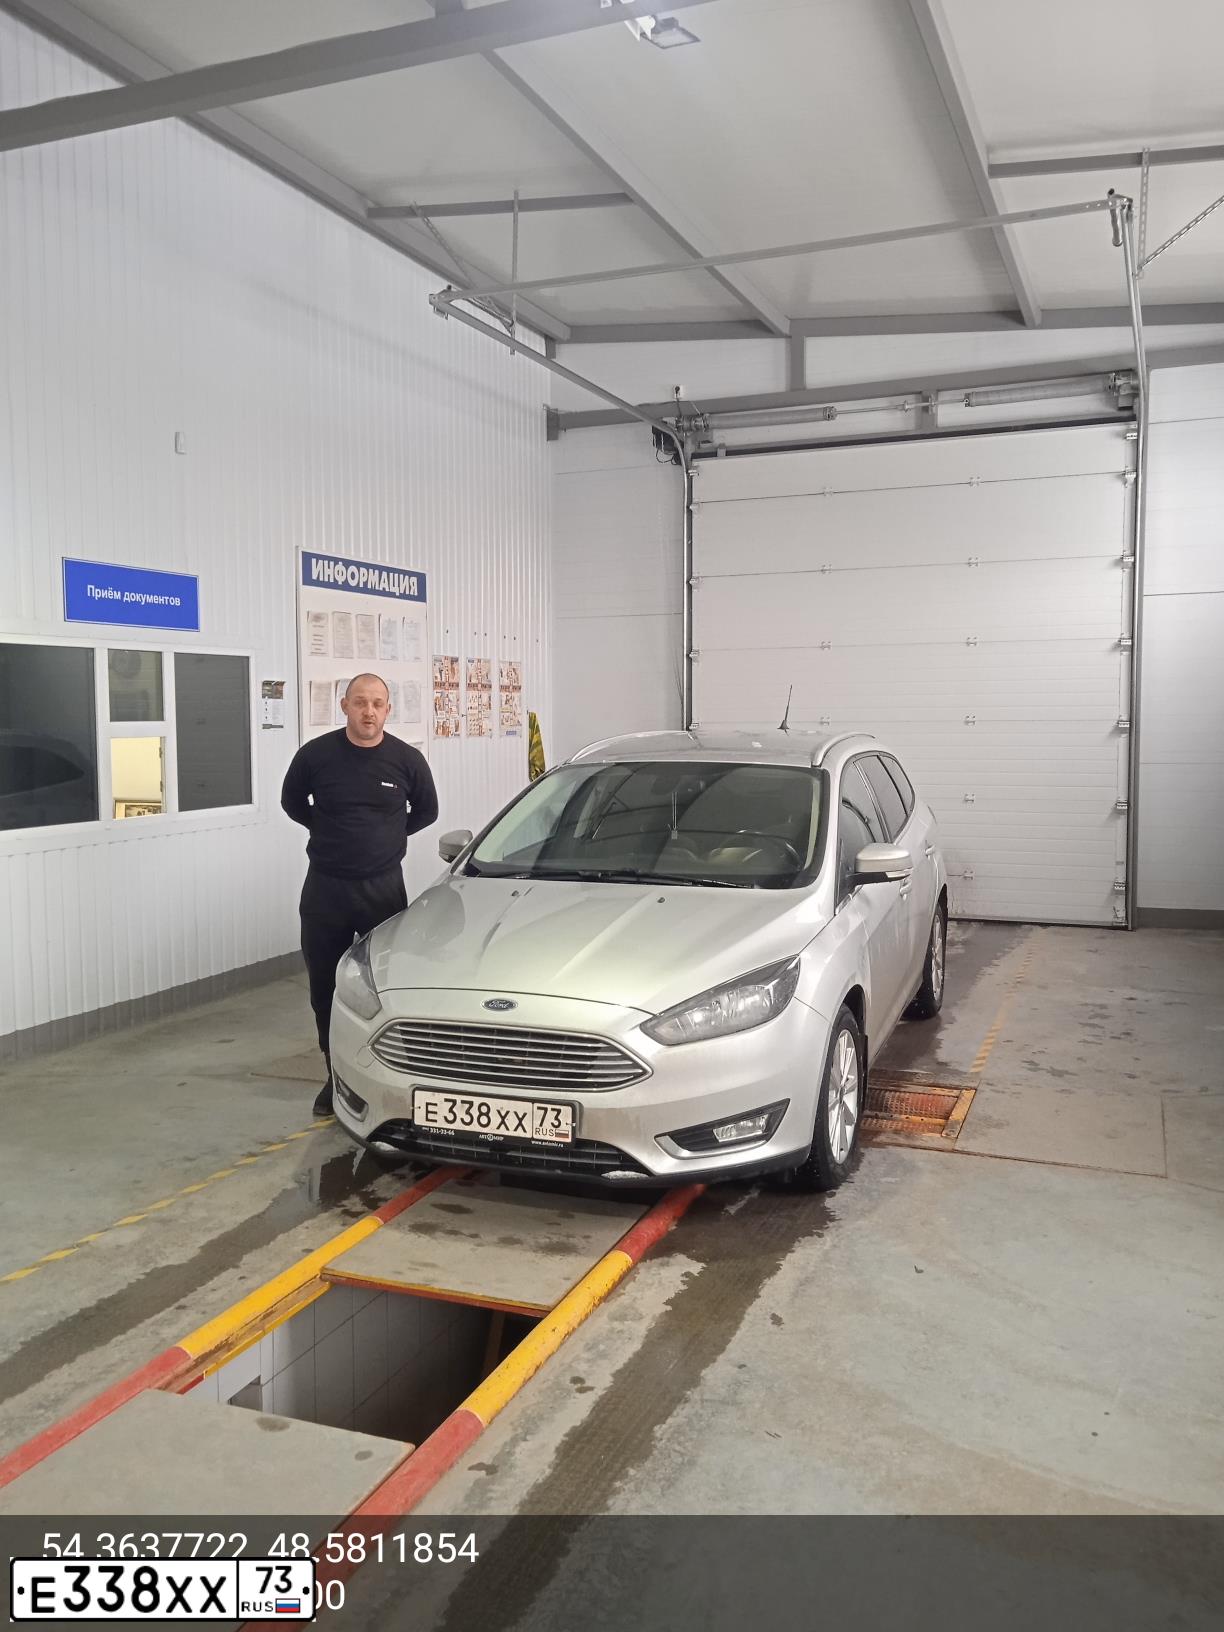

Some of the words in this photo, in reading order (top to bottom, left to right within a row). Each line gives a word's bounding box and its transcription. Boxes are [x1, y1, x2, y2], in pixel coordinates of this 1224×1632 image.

[311, 557, 419, 597] ИНФОРМАЦИЯ
[87, 584, 121, 600] Приём
[123, 591, 181, 606] документов
[536, 1105, 562, 1129] 73
[534, 1127, 555, 1137] RUS
